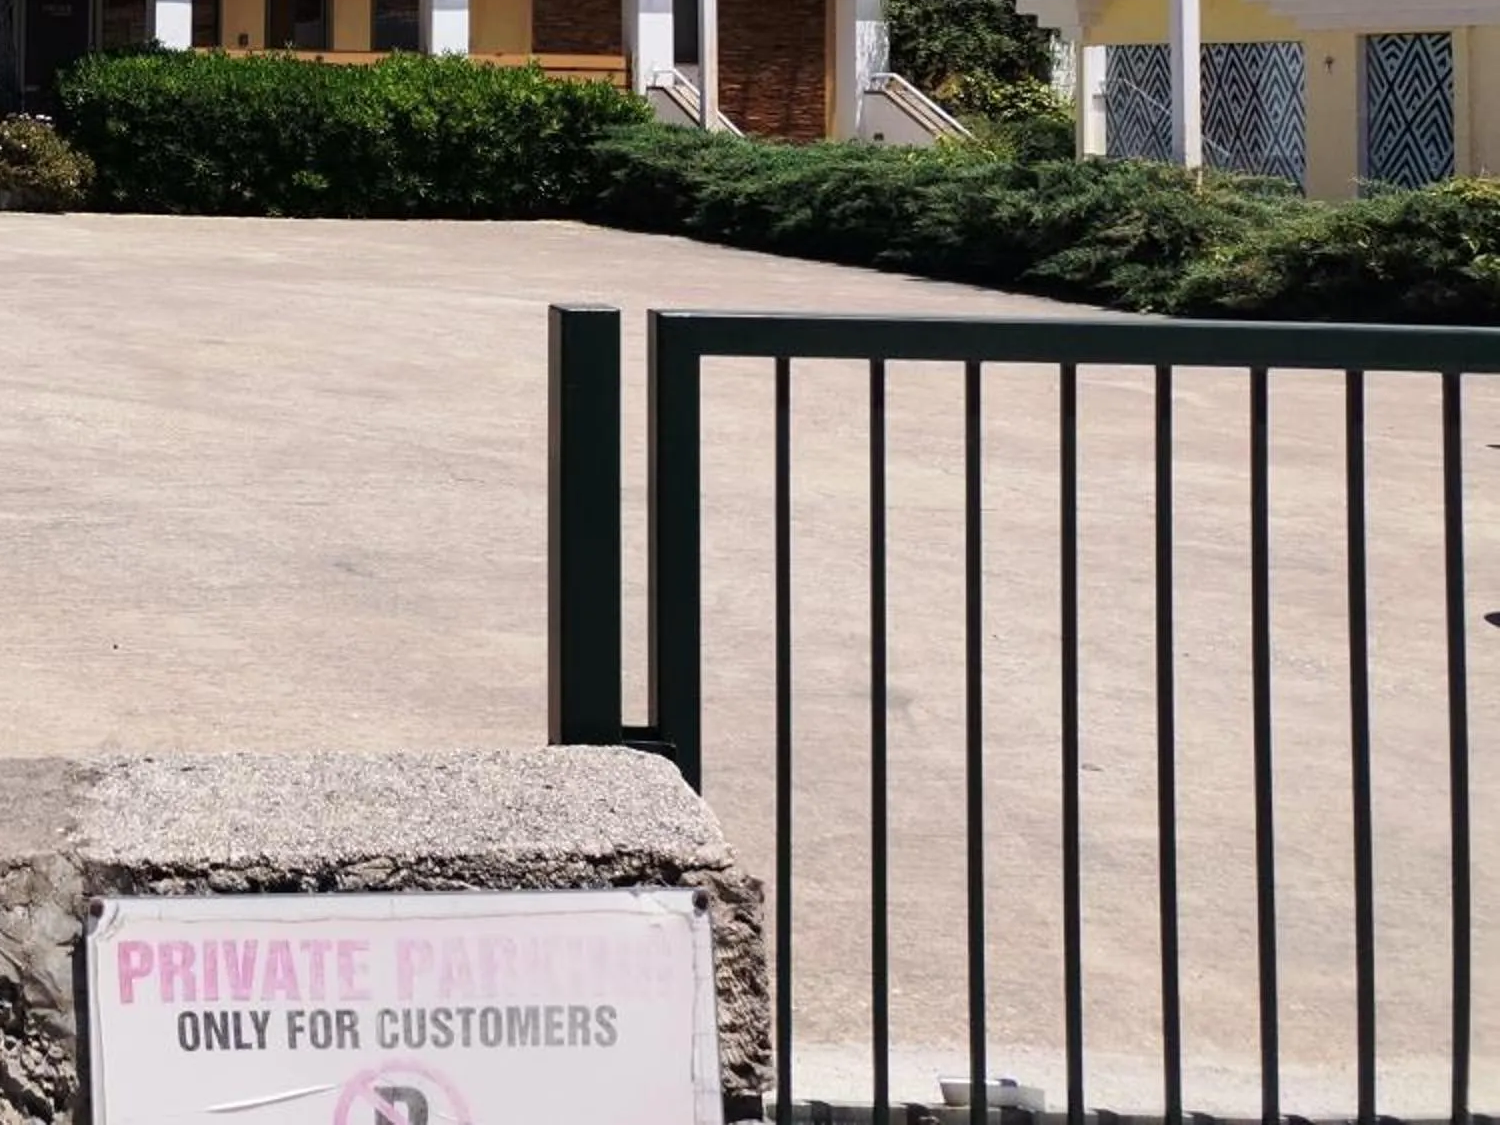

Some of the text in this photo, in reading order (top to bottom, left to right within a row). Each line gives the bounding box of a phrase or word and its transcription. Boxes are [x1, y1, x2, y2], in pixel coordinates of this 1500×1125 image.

[117, 939, 372, 1004] PRIVATE
[177, 1005, 618, 1051] ONLY FOR CUSTOMERS
